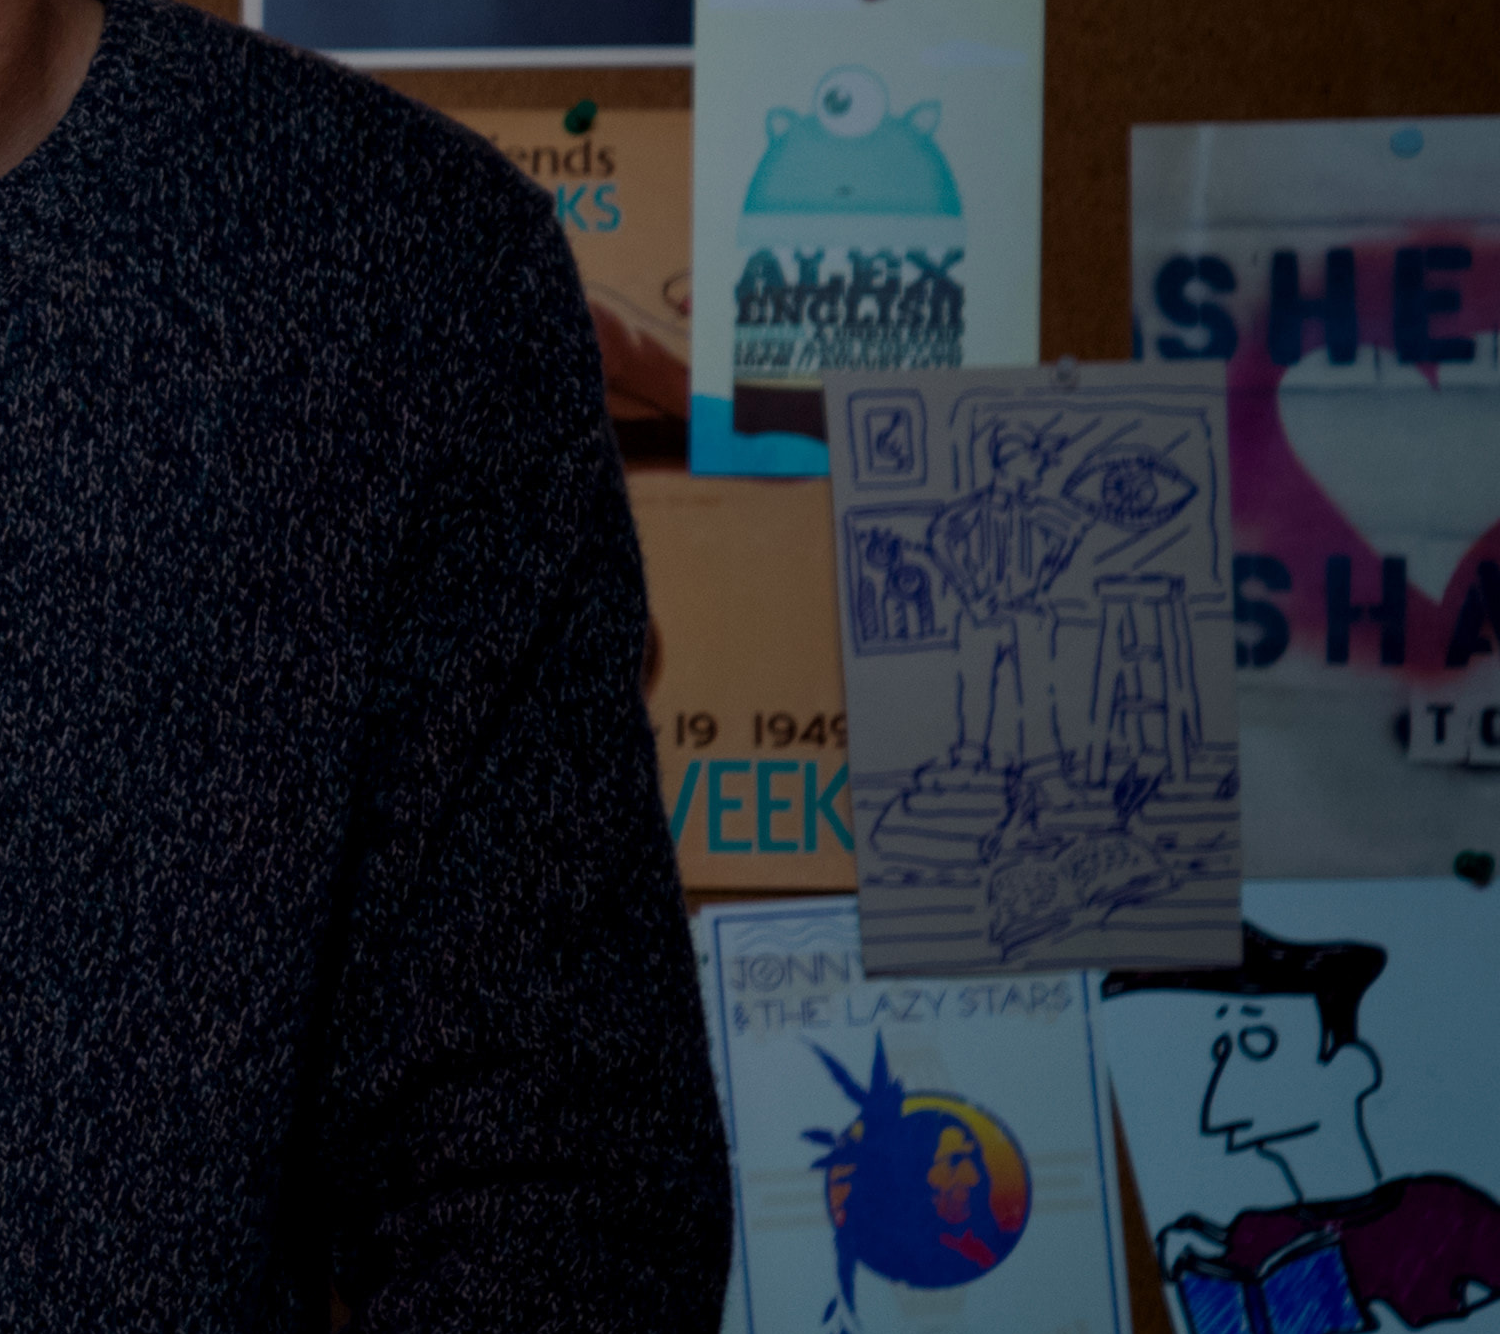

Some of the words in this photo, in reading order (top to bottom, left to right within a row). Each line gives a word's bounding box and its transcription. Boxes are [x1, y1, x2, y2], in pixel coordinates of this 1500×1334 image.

[735, 247, 965, 299] ALEX
[1153, 244, 1477, 366] SHE
[676, 711, 719, 748] 19
[733, 1001, 749, 1031] &
[755, 995, 831, 1029] THE
[845, 989, 947, 1027] LAZY
[958, 981, 1073, 1019] STARS
